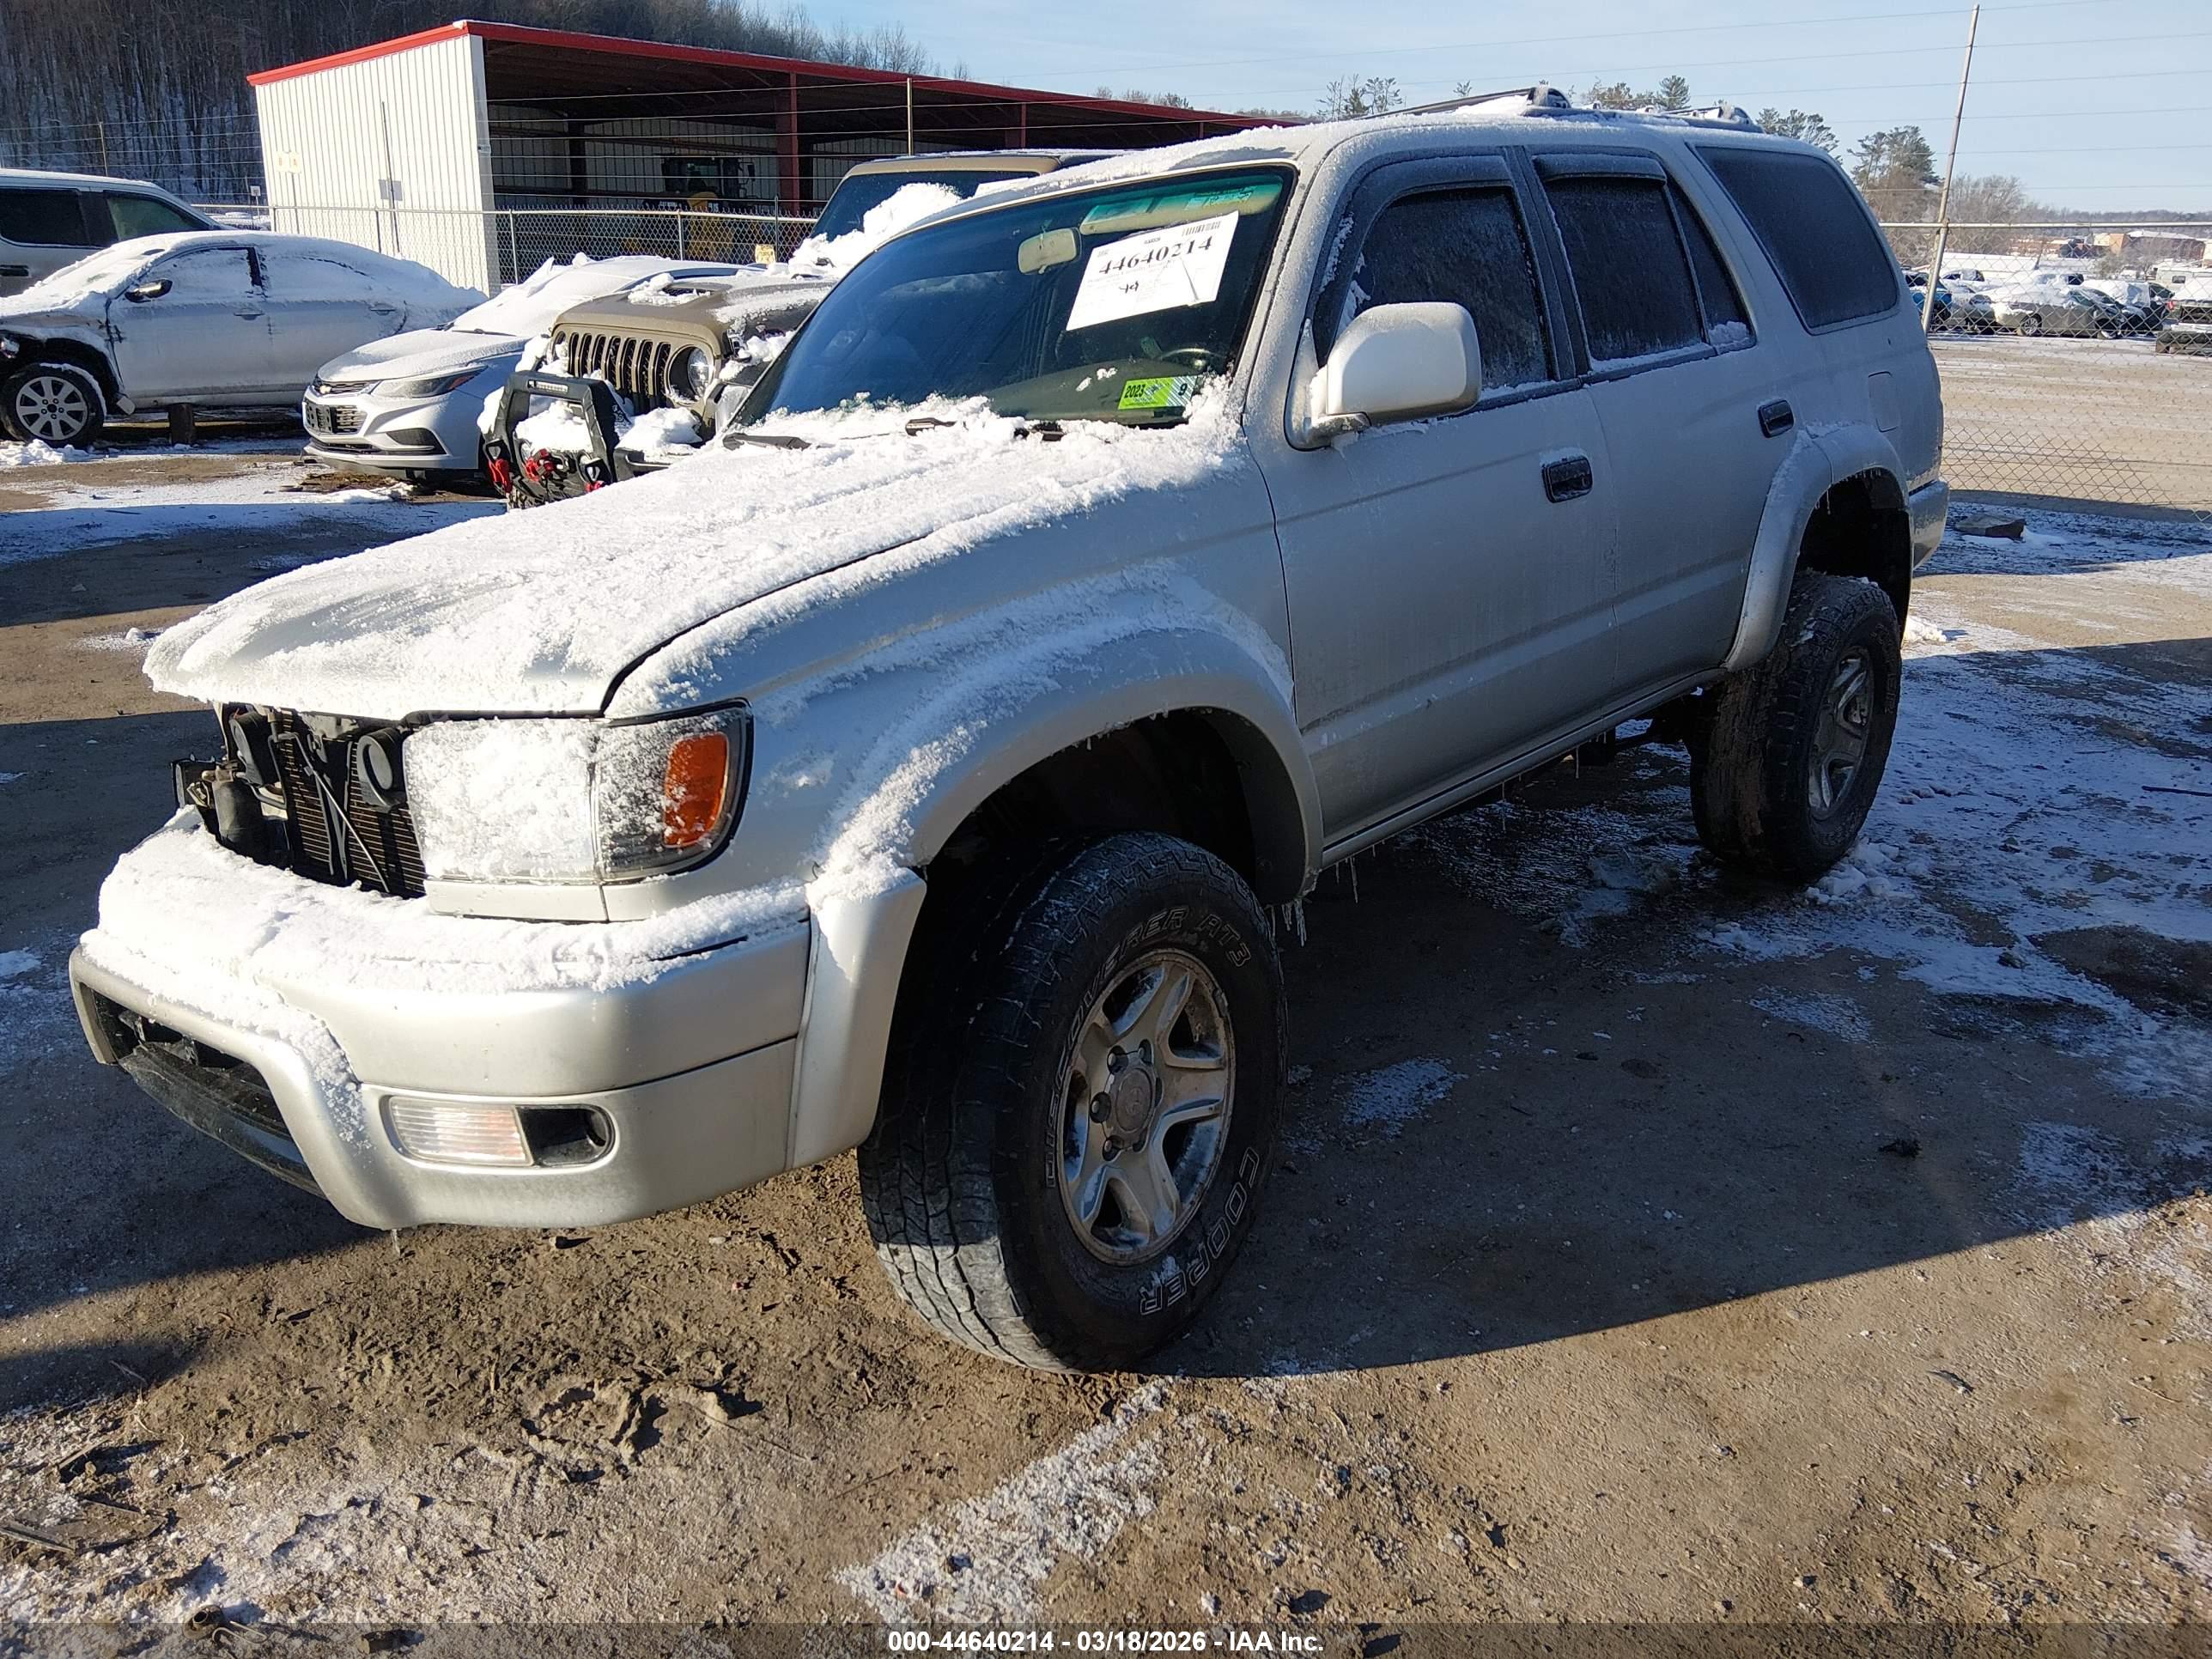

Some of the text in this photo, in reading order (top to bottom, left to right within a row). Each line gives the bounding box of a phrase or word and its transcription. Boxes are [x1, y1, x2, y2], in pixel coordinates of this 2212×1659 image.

[1098, 235, 1213, 275] 44640214
[1123, 384, 1146, 398] 2023
[1178, 383, 1188, 396] 9
[1045, 907, 1252, 1188] DISCOVERER AT3
[1139, 1146, 1261, 1316] COOPER
